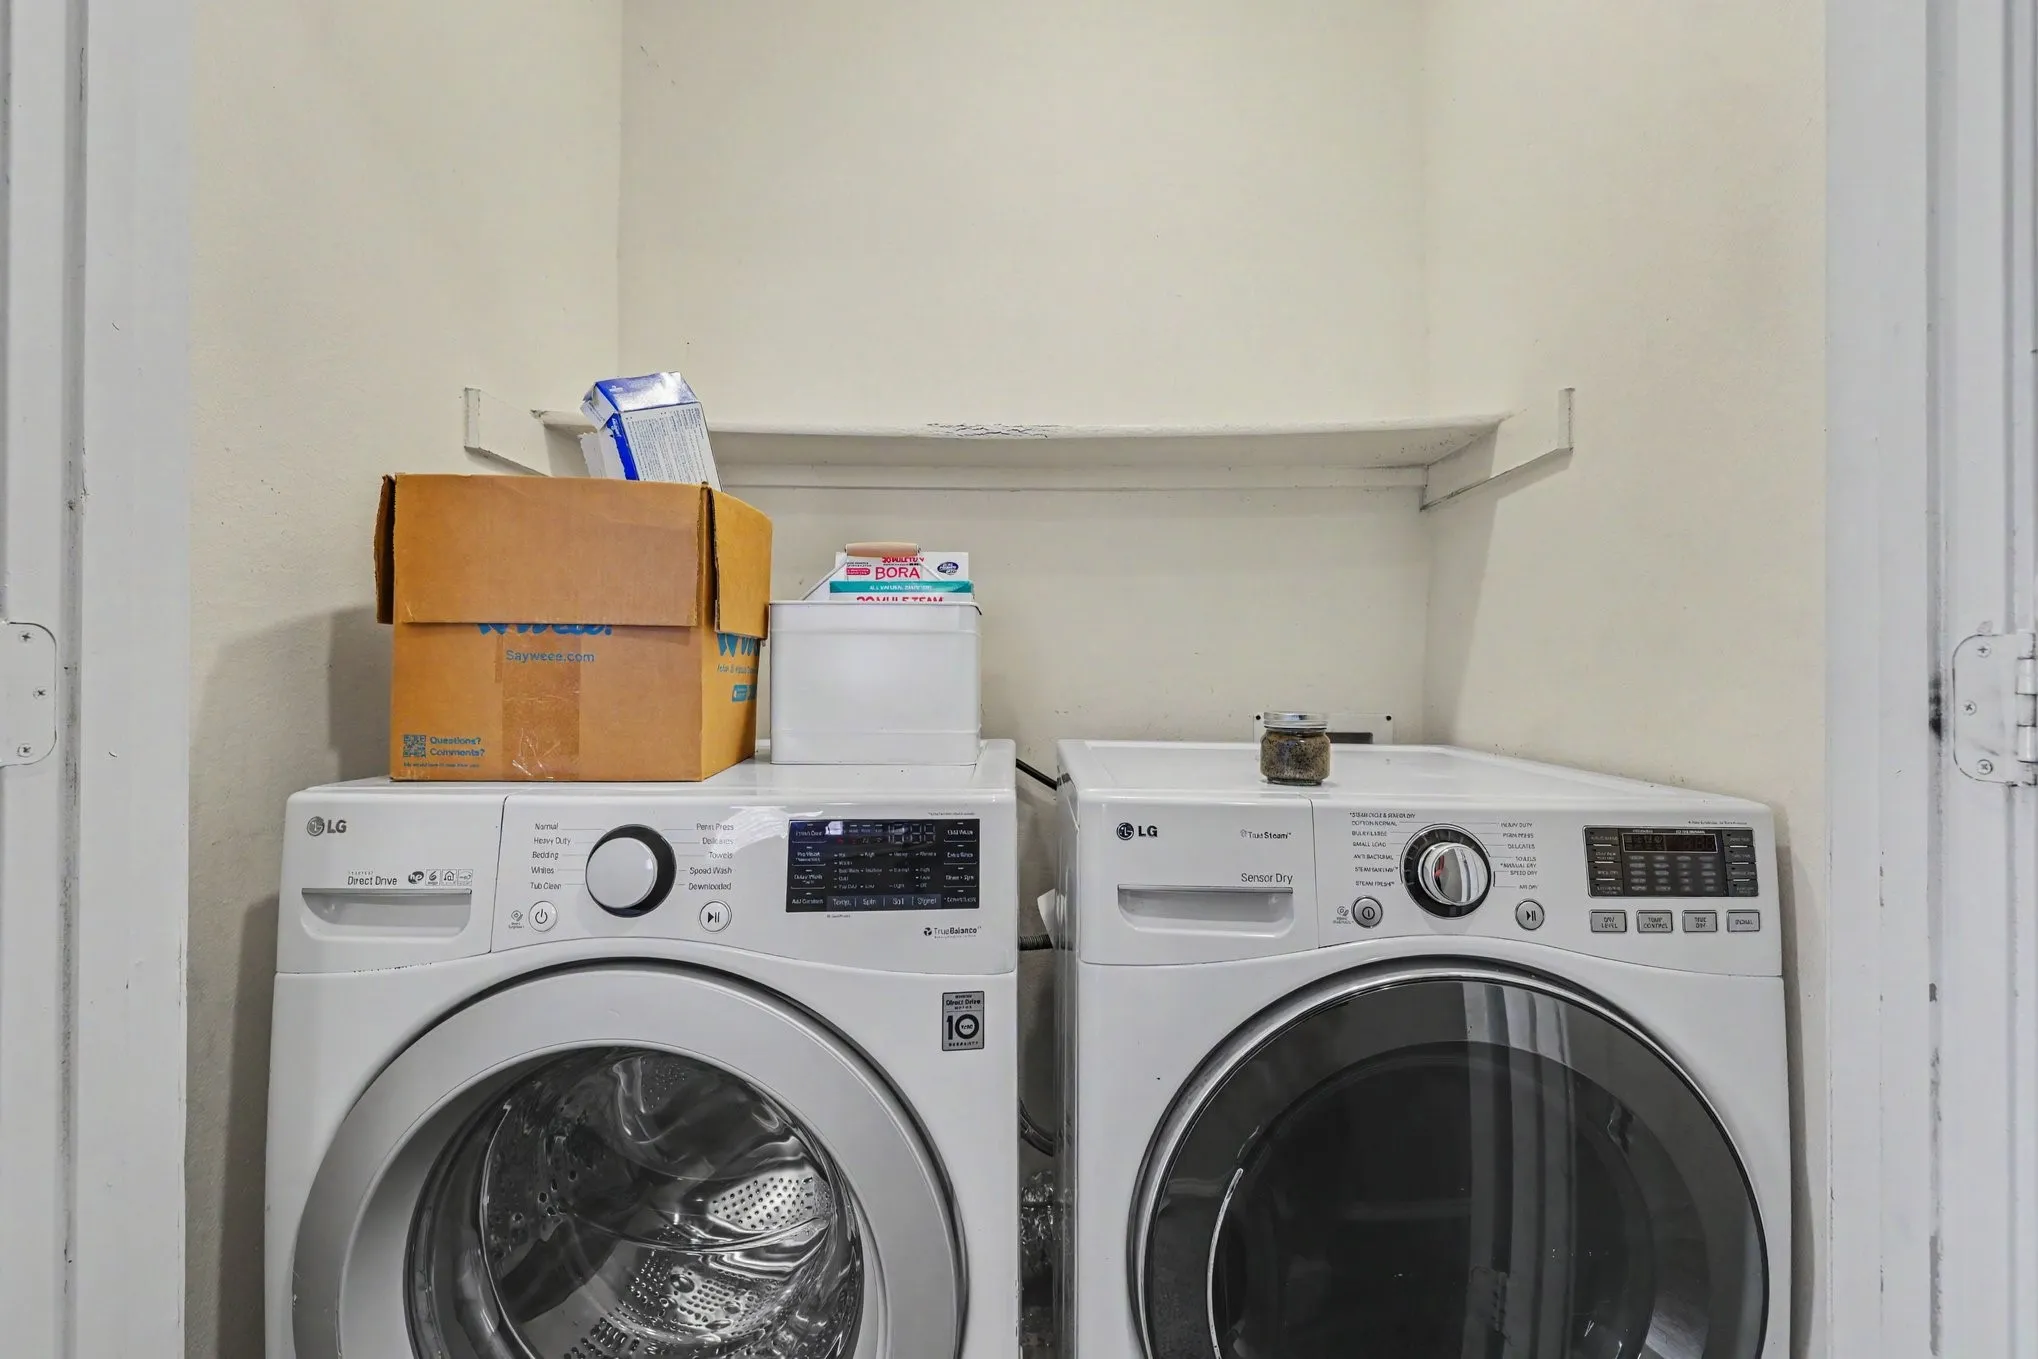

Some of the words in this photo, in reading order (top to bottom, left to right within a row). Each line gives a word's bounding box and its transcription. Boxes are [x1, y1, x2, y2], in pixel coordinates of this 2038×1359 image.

[875, 566, 920, 580] BORA
[506, 650, 595, 664] Sayweee.com
[430, 736, 482, 746] Questions?
[430, 748, 485, 757] Comments?
[327, 820, 347, 834] LG
[534, 822, 559, 830] Normal
[1138, 826, 1158, 838] LG
[534, 837, 554, 846] Heavy
[556, 837, 571, 845] Duty
[532, 851, 559, 860] Bedding
[531, 866, 555, 874] Whites
[348, 876, 373, 886] Direct
[375, 876, 398, 886] Drive
[1241, 873, 1273, 883] Sensor
[1275, 873, 1293, 884] Dry
[530, 882, 542, 890] Tub
[544, 882, 562, 890] Clean
[946, 1014, 980, 1040] 10
